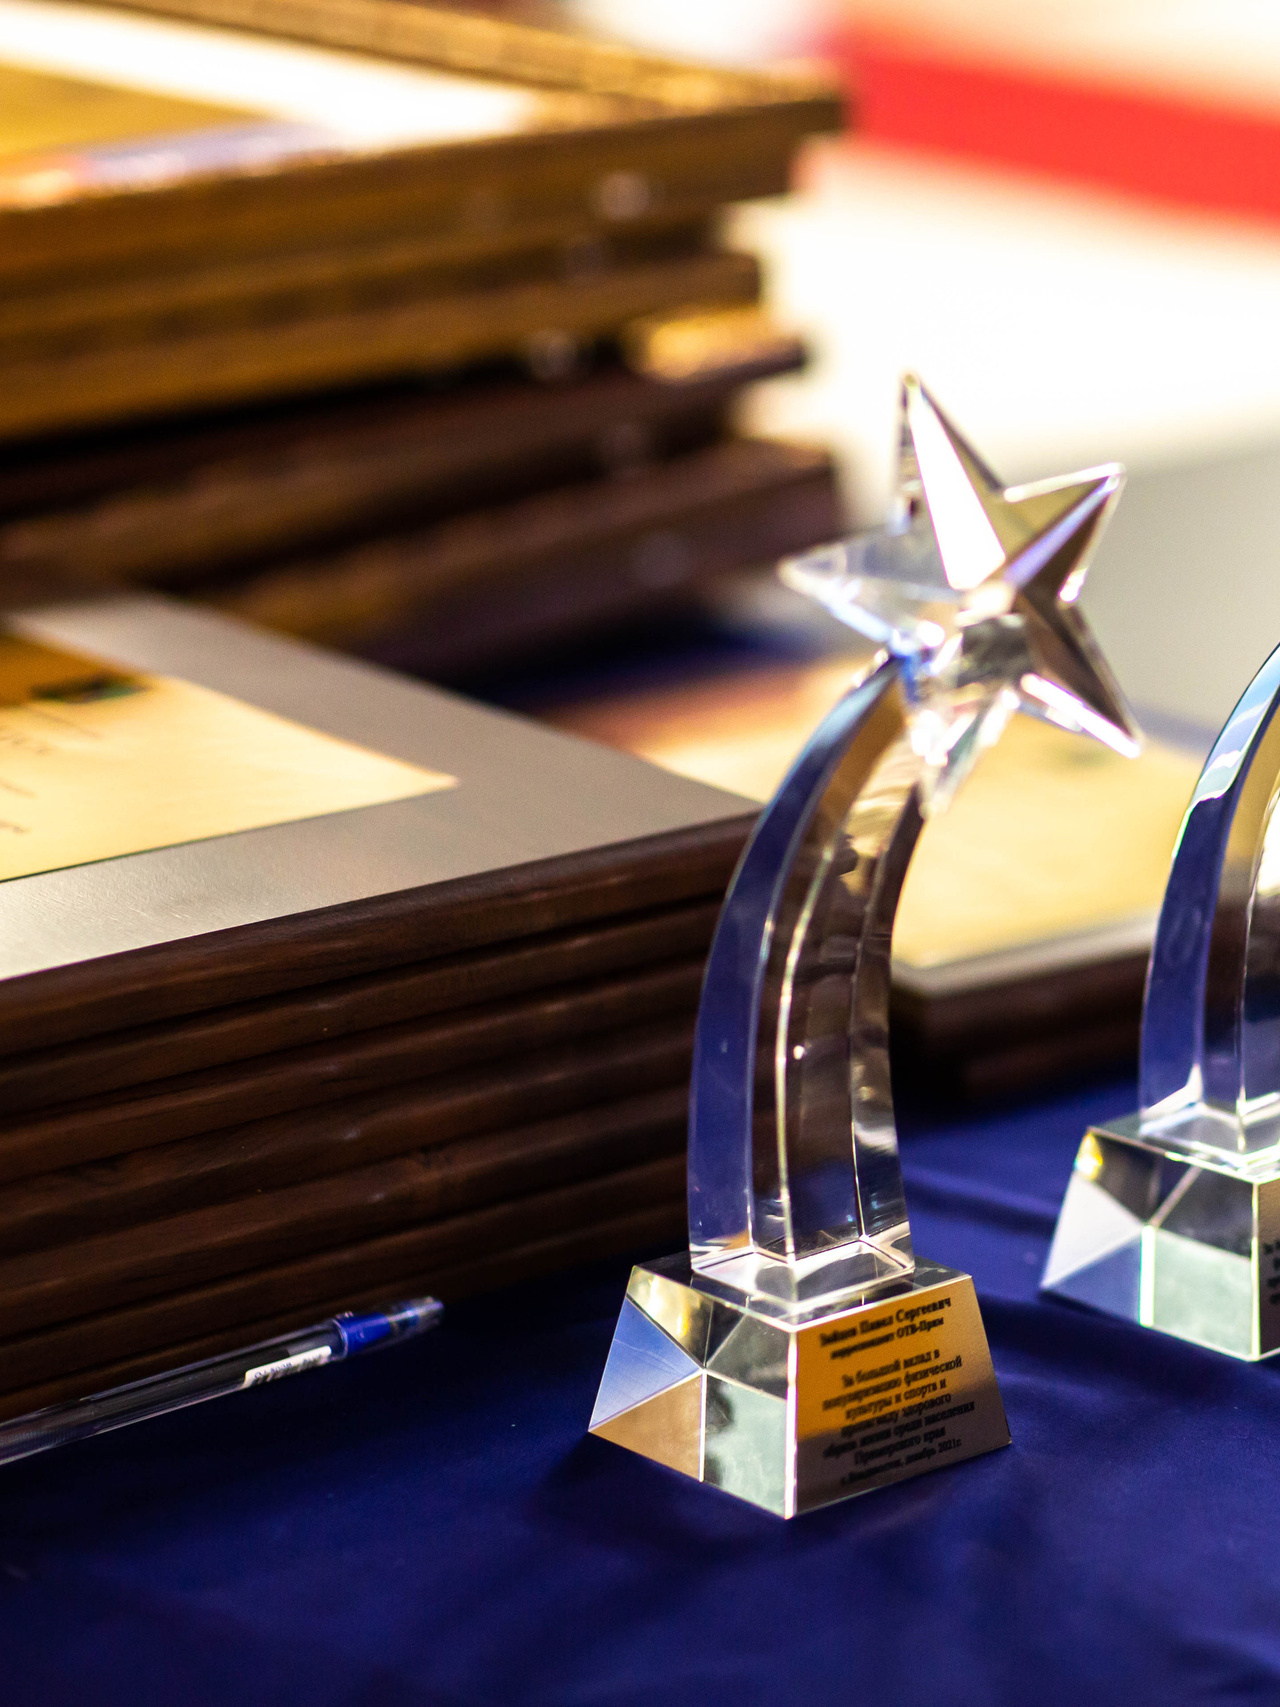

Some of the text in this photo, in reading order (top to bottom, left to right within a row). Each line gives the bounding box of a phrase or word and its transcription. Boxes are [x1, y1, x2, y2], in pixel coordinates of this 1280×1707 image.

[896, 1298, 951, 1321] Сергеевич
[855, 1359, 901, 1383] большой
[904, 1351, 932, 1369] вклад
[904, 1355, 962, 1387] физической
[846, 1396, 893, 1421] культуры
[904, 1381, 937, 1400] спорта
[901, 1393, 951, 1416] здорового
[893, 1418, 922, 1437] среди
[924, 1401, 975, 1426] населения
[923, 1427, 946, 1443] края
